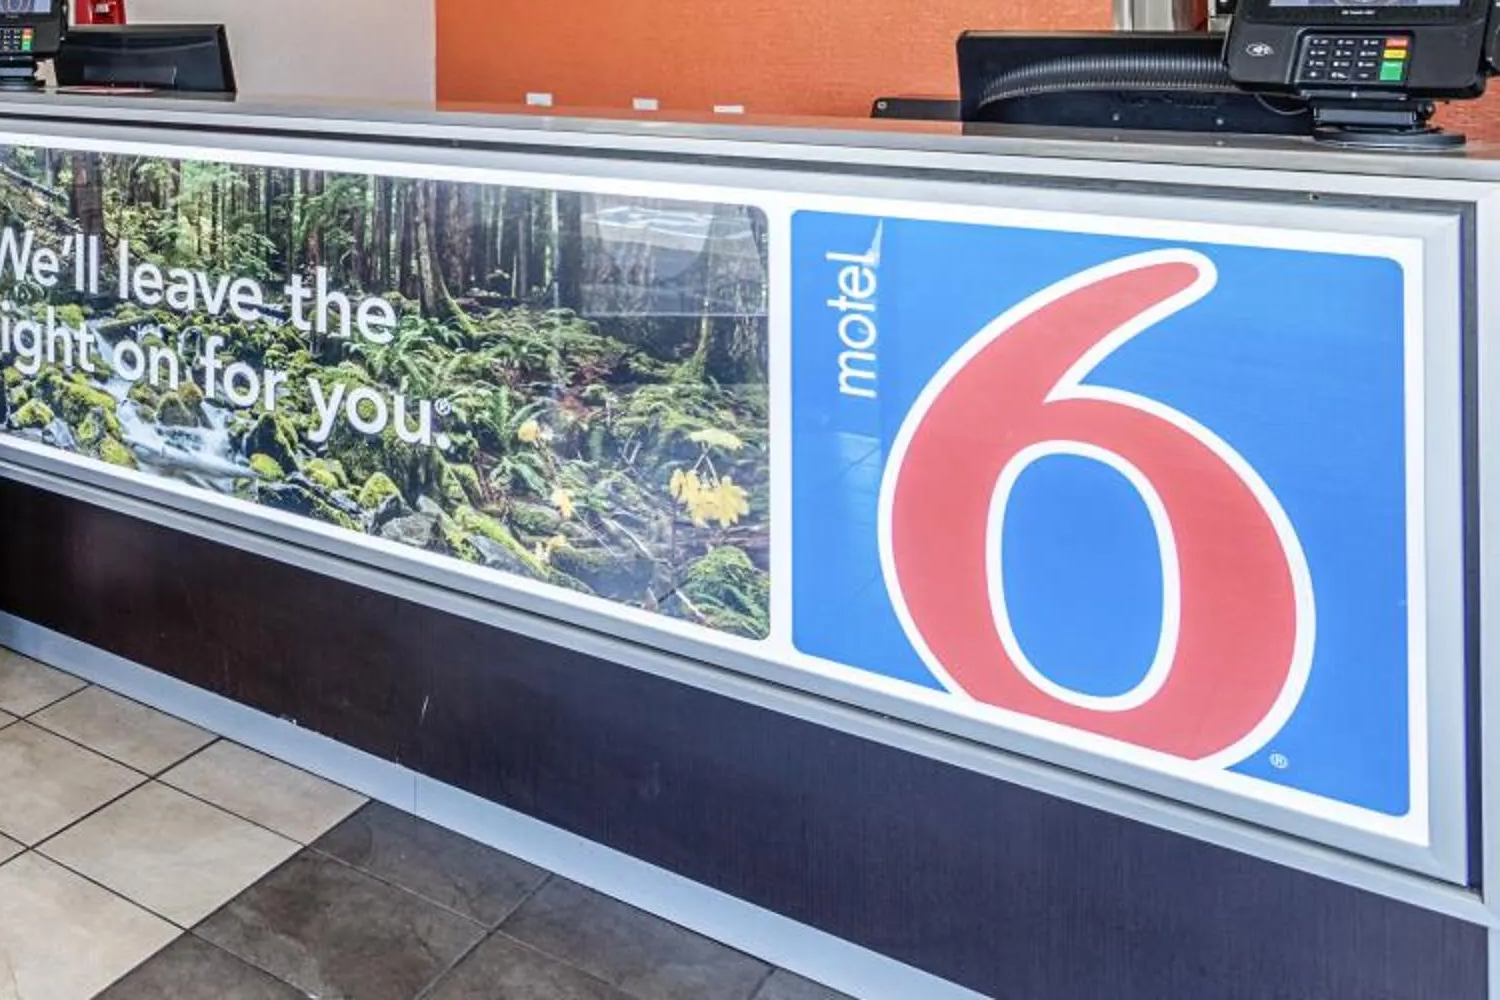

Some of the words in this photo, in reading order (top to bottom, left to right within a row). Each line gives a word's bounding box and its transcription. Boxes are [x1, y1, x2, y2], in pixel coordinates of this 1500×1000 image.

[118, 239, 263, 322] leave
[285, 266, 398, 344] the
[825, 251, 878, 399] motel
[113, 338, 179, 391] on
[199, 335, 288, 412] for
[877, 247, 1316, 770] 6
